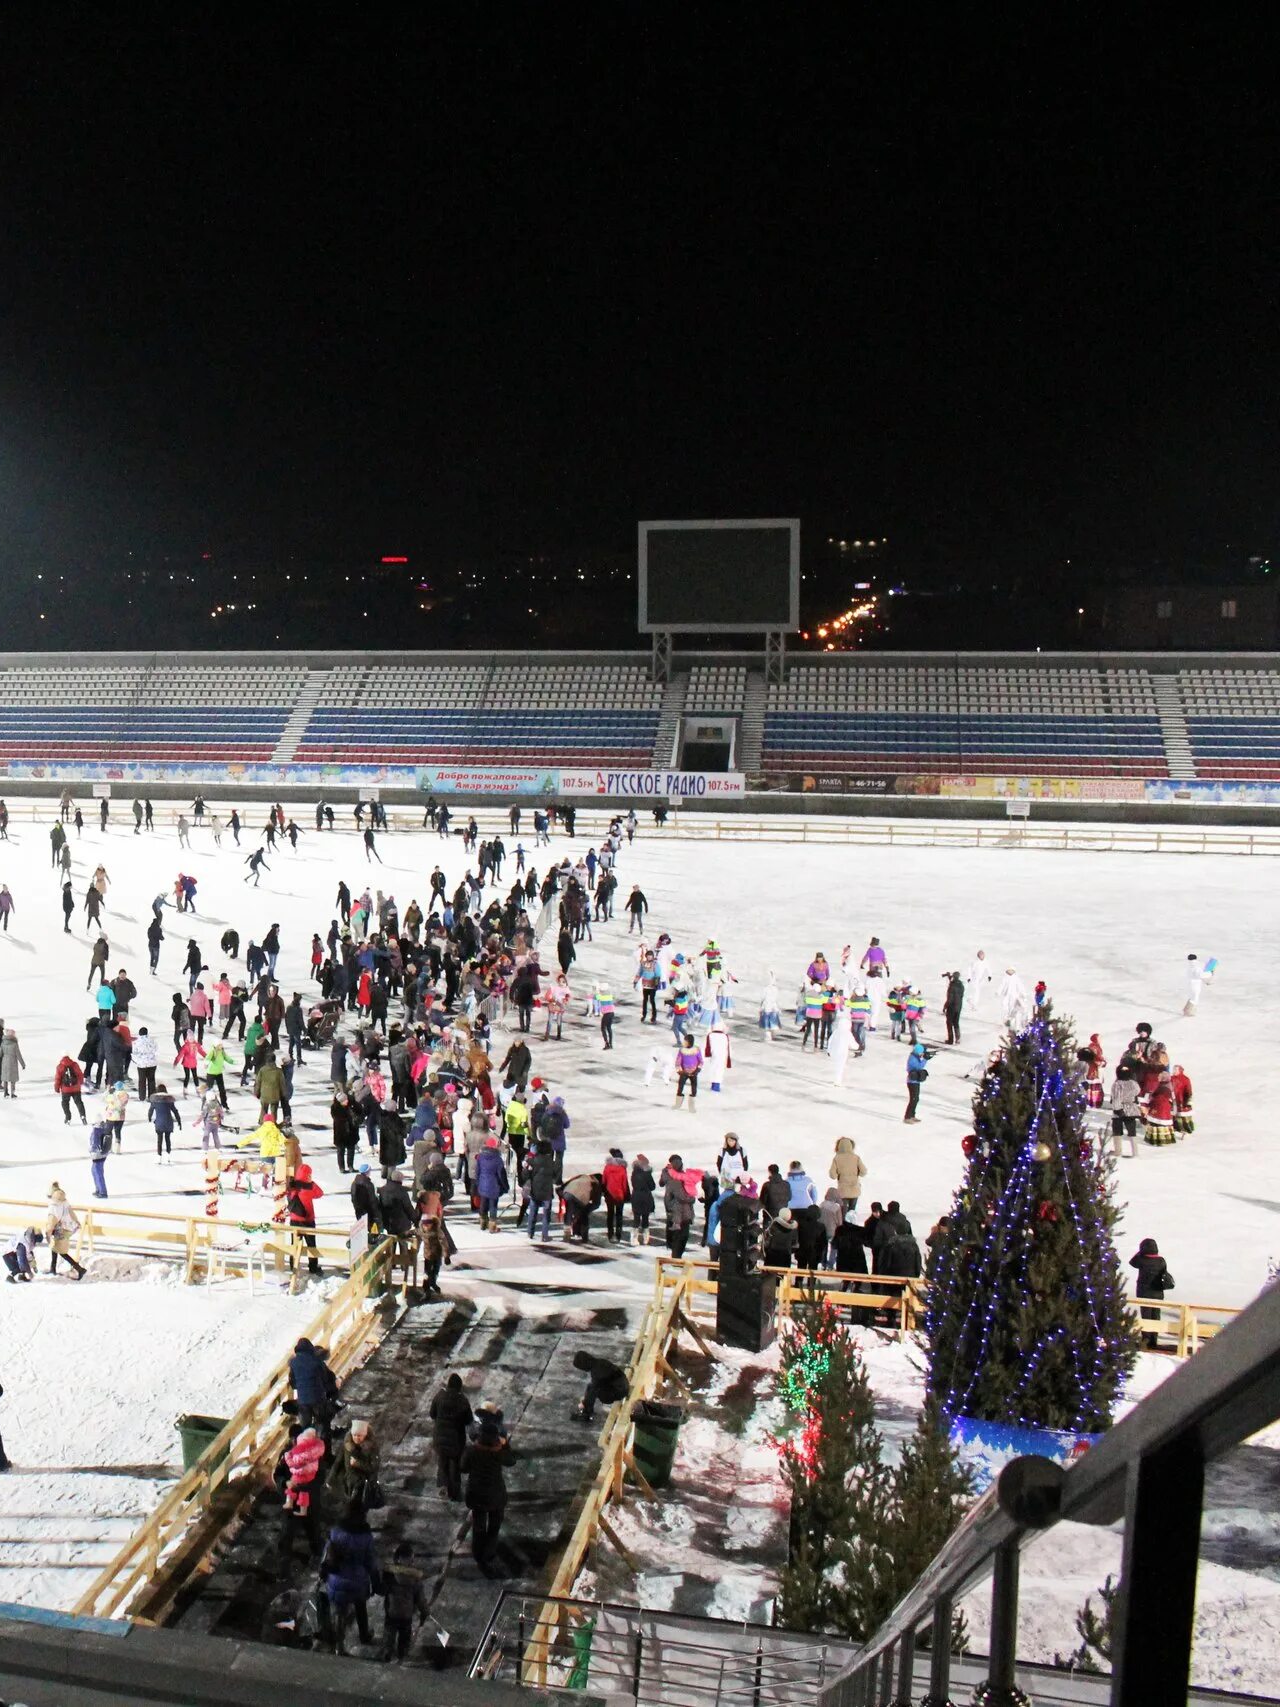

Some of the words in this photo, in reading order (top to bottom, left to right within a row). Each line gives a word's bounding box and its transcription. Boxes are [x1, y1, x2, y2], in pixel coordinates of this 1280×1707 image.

[436, 772, 469, 781] Добро
[471, 773, 539, 781] пожаловать!
[455, 782, 482, 791] Амар
[607, 774, 661, 795] РУССКОЕ
[666, 775, 706, 796] РАДИО
[818, 778, 843, 786] SPARTA
